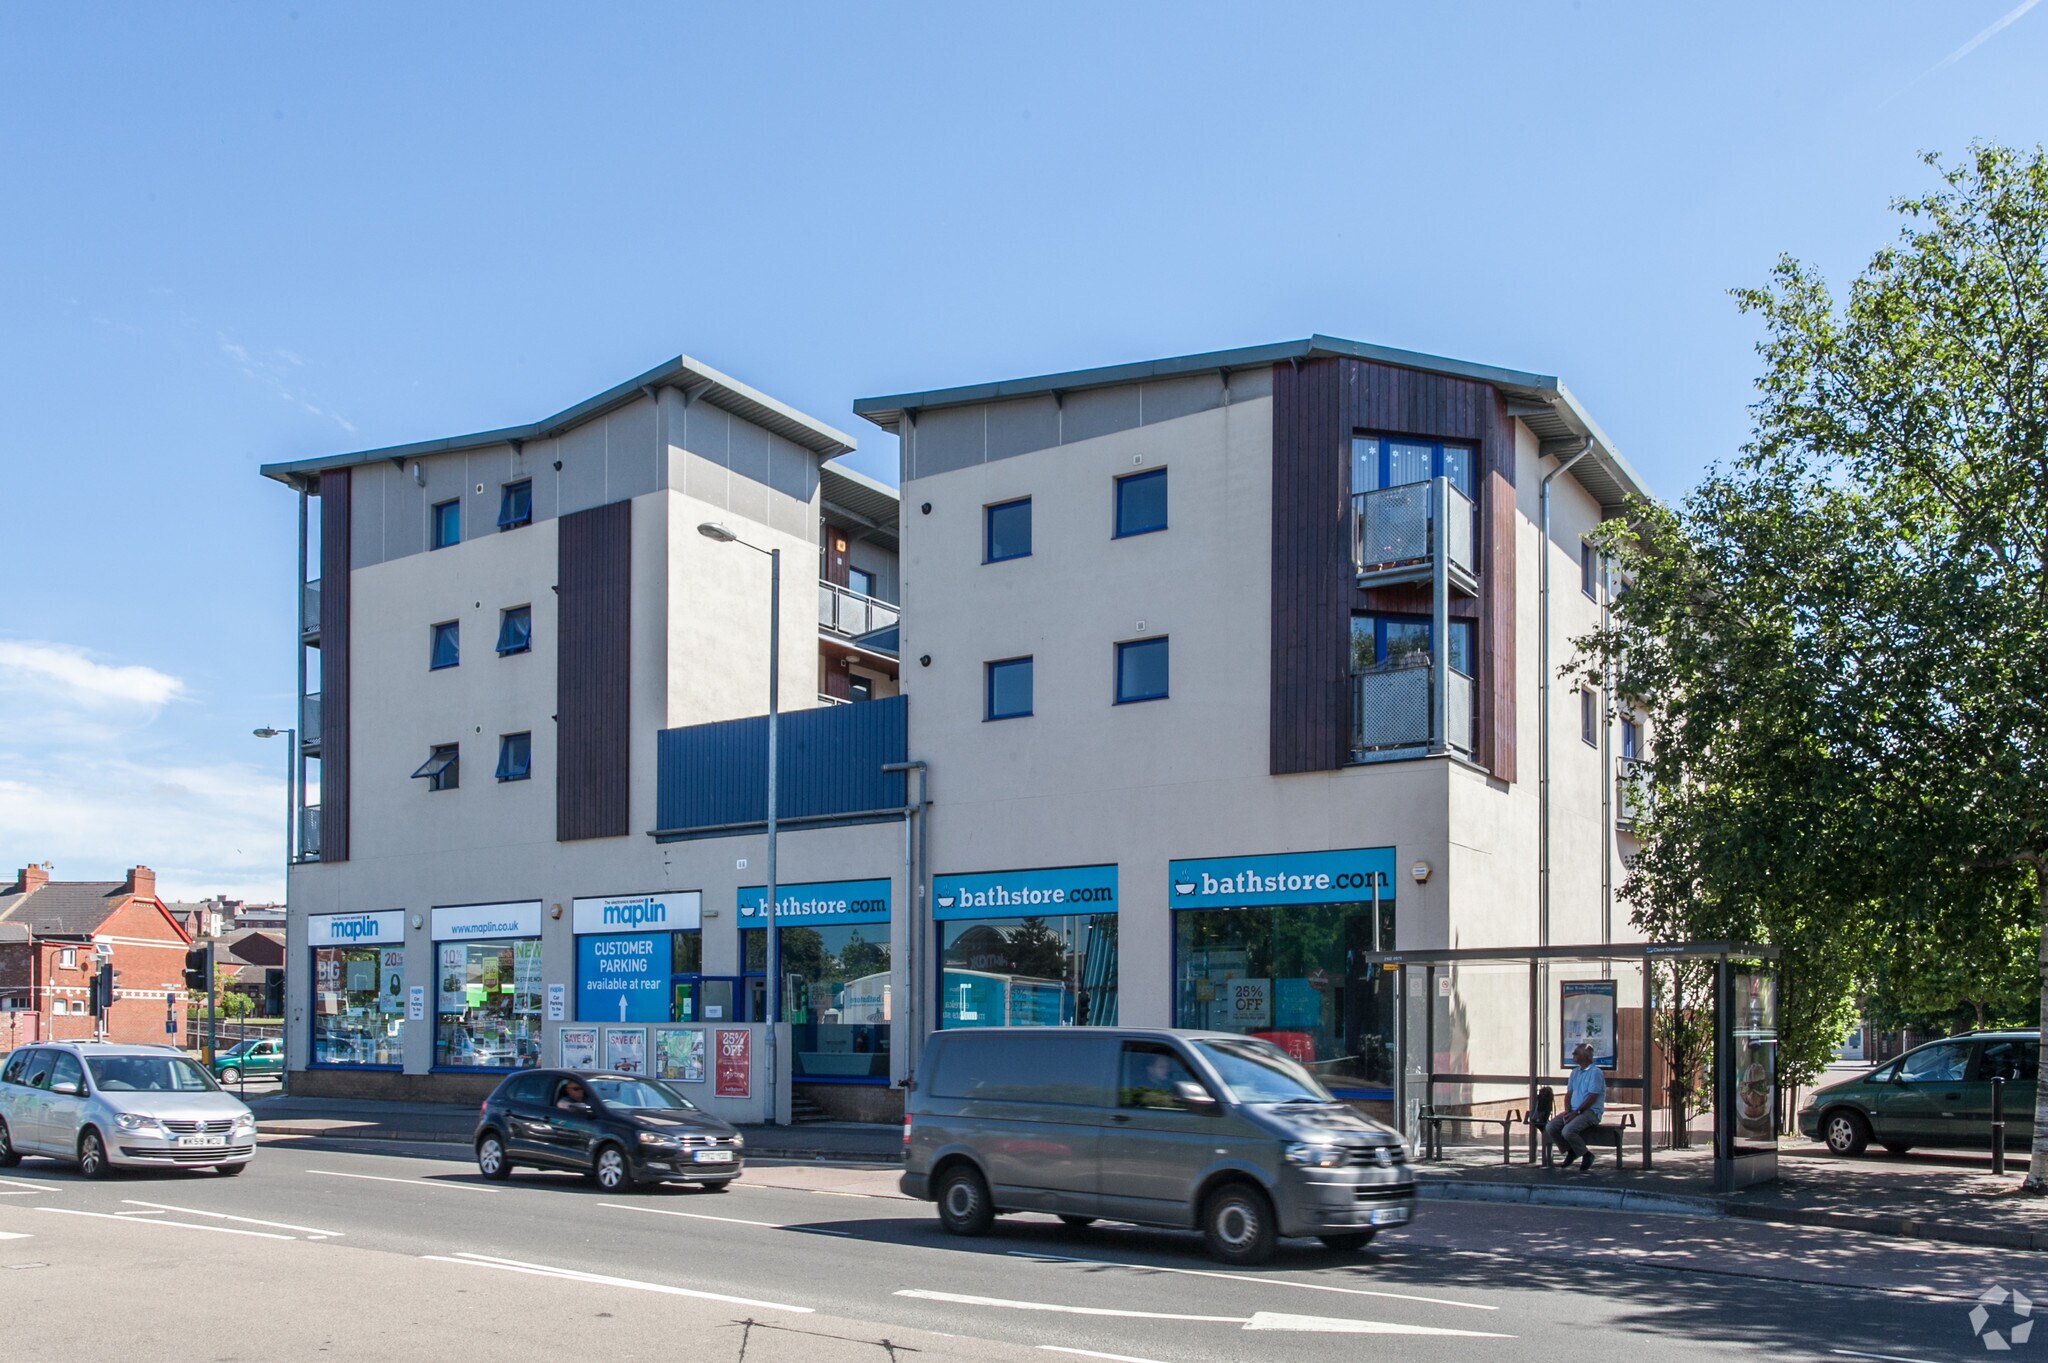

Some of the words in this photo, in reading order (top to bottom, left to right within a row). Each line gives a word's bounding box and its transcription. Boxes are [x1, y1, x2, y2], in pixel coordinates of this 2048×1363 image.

[1201, 870, 1389, 895] bathstore.com
[959, 885, 1113, 908] bathstore.com
[603, 898, 666, 928] maplin
[759, 896, 887, 917] bathstore.com
[331, 915, 379, 941] maplin
[451, 920, 519, 934] www.maplin.co.uk
[594, 940, 653, 956] CUSTOMER
[318, 960, 340, 980] BIG
[600, 958, 648, 973] PARKING
[586, 977, 628, 990] available
[629, 978, 639, 990] at
[640, 979, 661, 990] rear
[1235, 985, 1263, 998] 25%
[1235, 998, 1263, 1011] OFF
[564, 1034, 580, 1043] SAVE
[611, 1035, 629, 1045] SAVE
[722, 1032, 744, 1045] 25%
[722, 1044, 744, 1057] OFF
